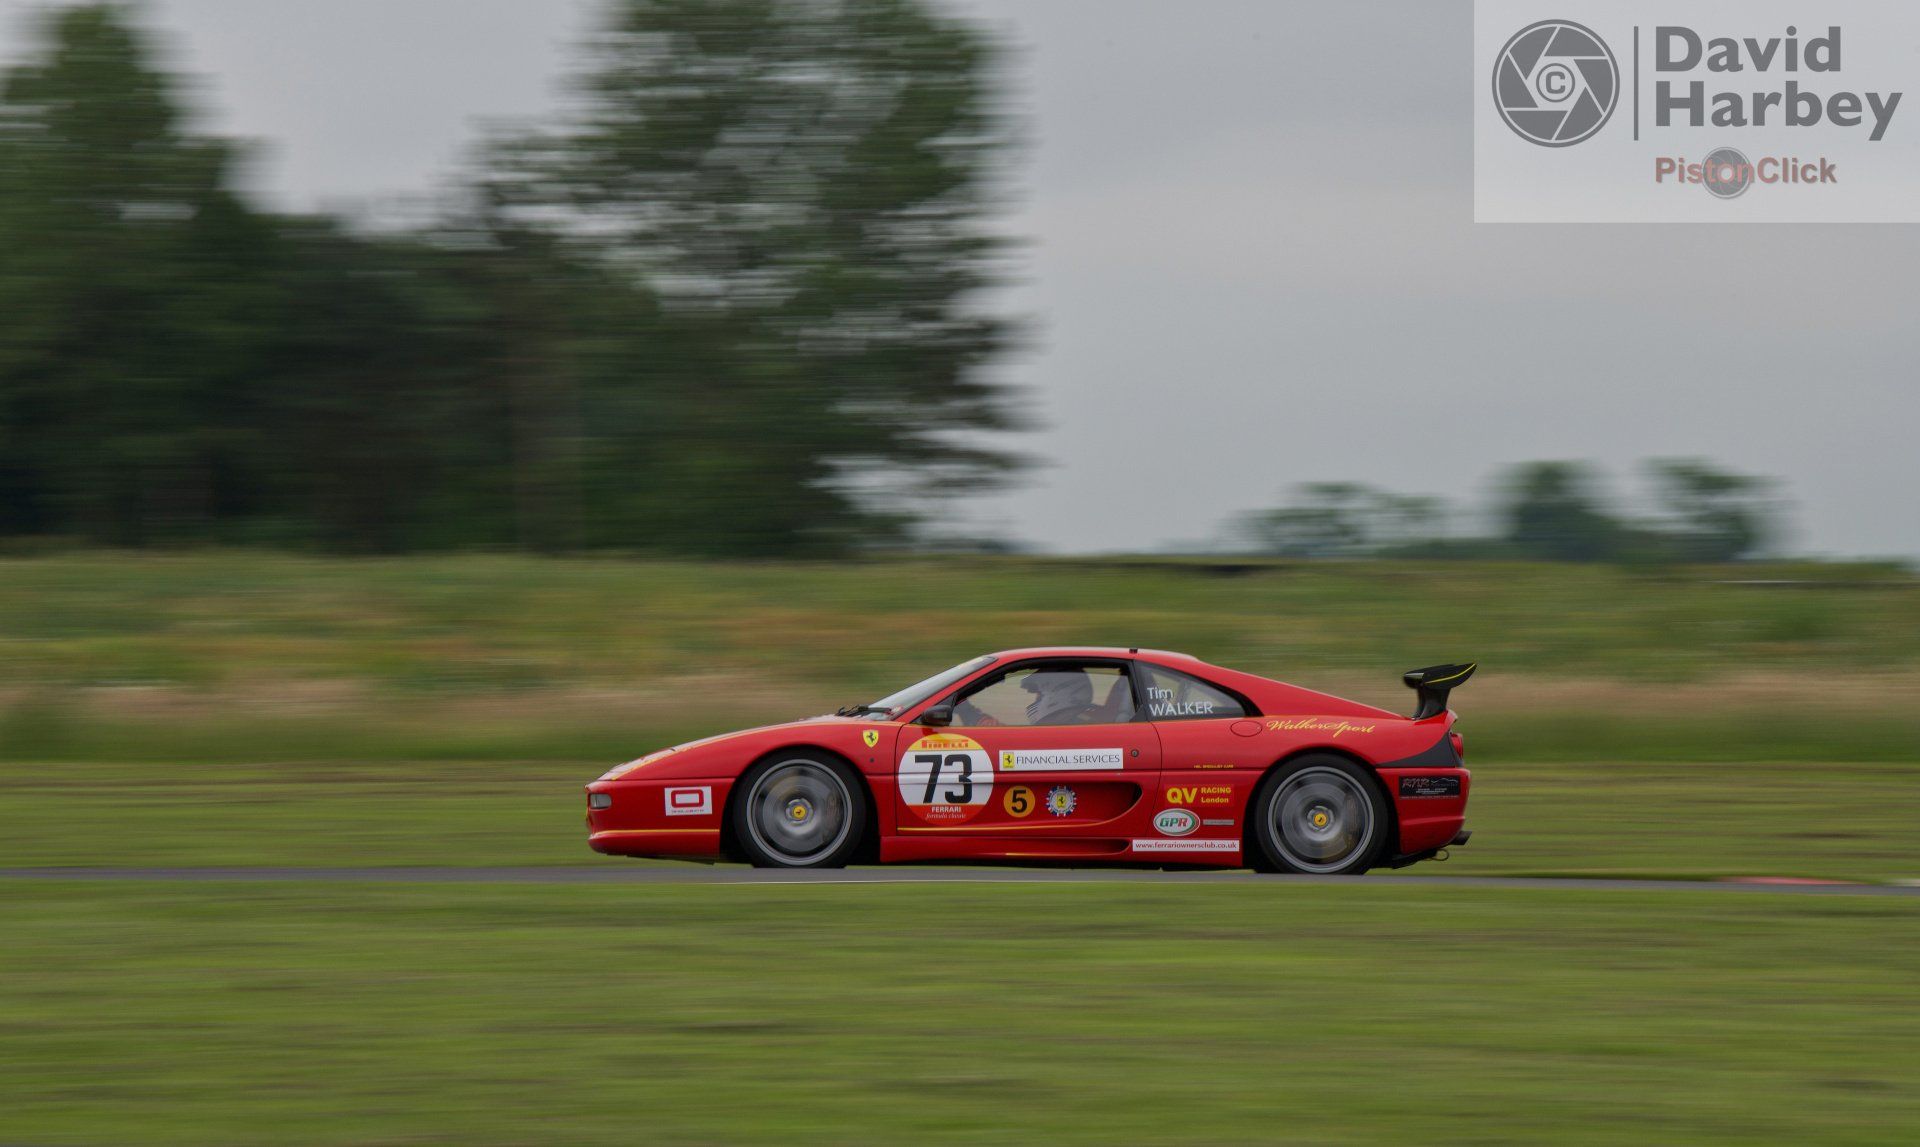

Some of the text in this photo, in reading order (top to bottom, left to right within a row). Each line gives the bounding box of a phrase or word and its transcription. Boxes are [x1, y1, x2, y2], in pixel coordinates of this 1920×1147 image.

[1147, 687, 1173, 699] Tim
[1149, 701, 1214, 716] WALKER
[921, 740, 969, 749] PIRELLI
[1016, 754, 1121, 765] FINANCIAL SERVICES
[914, 754, 973, 804] 73
[1011, 789, 1028, 814] 5
[1166, 786, 1232, 805] QV RACING
[1160, 818, 1188, 828] GPR
[1135, 841, 1237, 849] www.ferrariownersclub.co.uk
